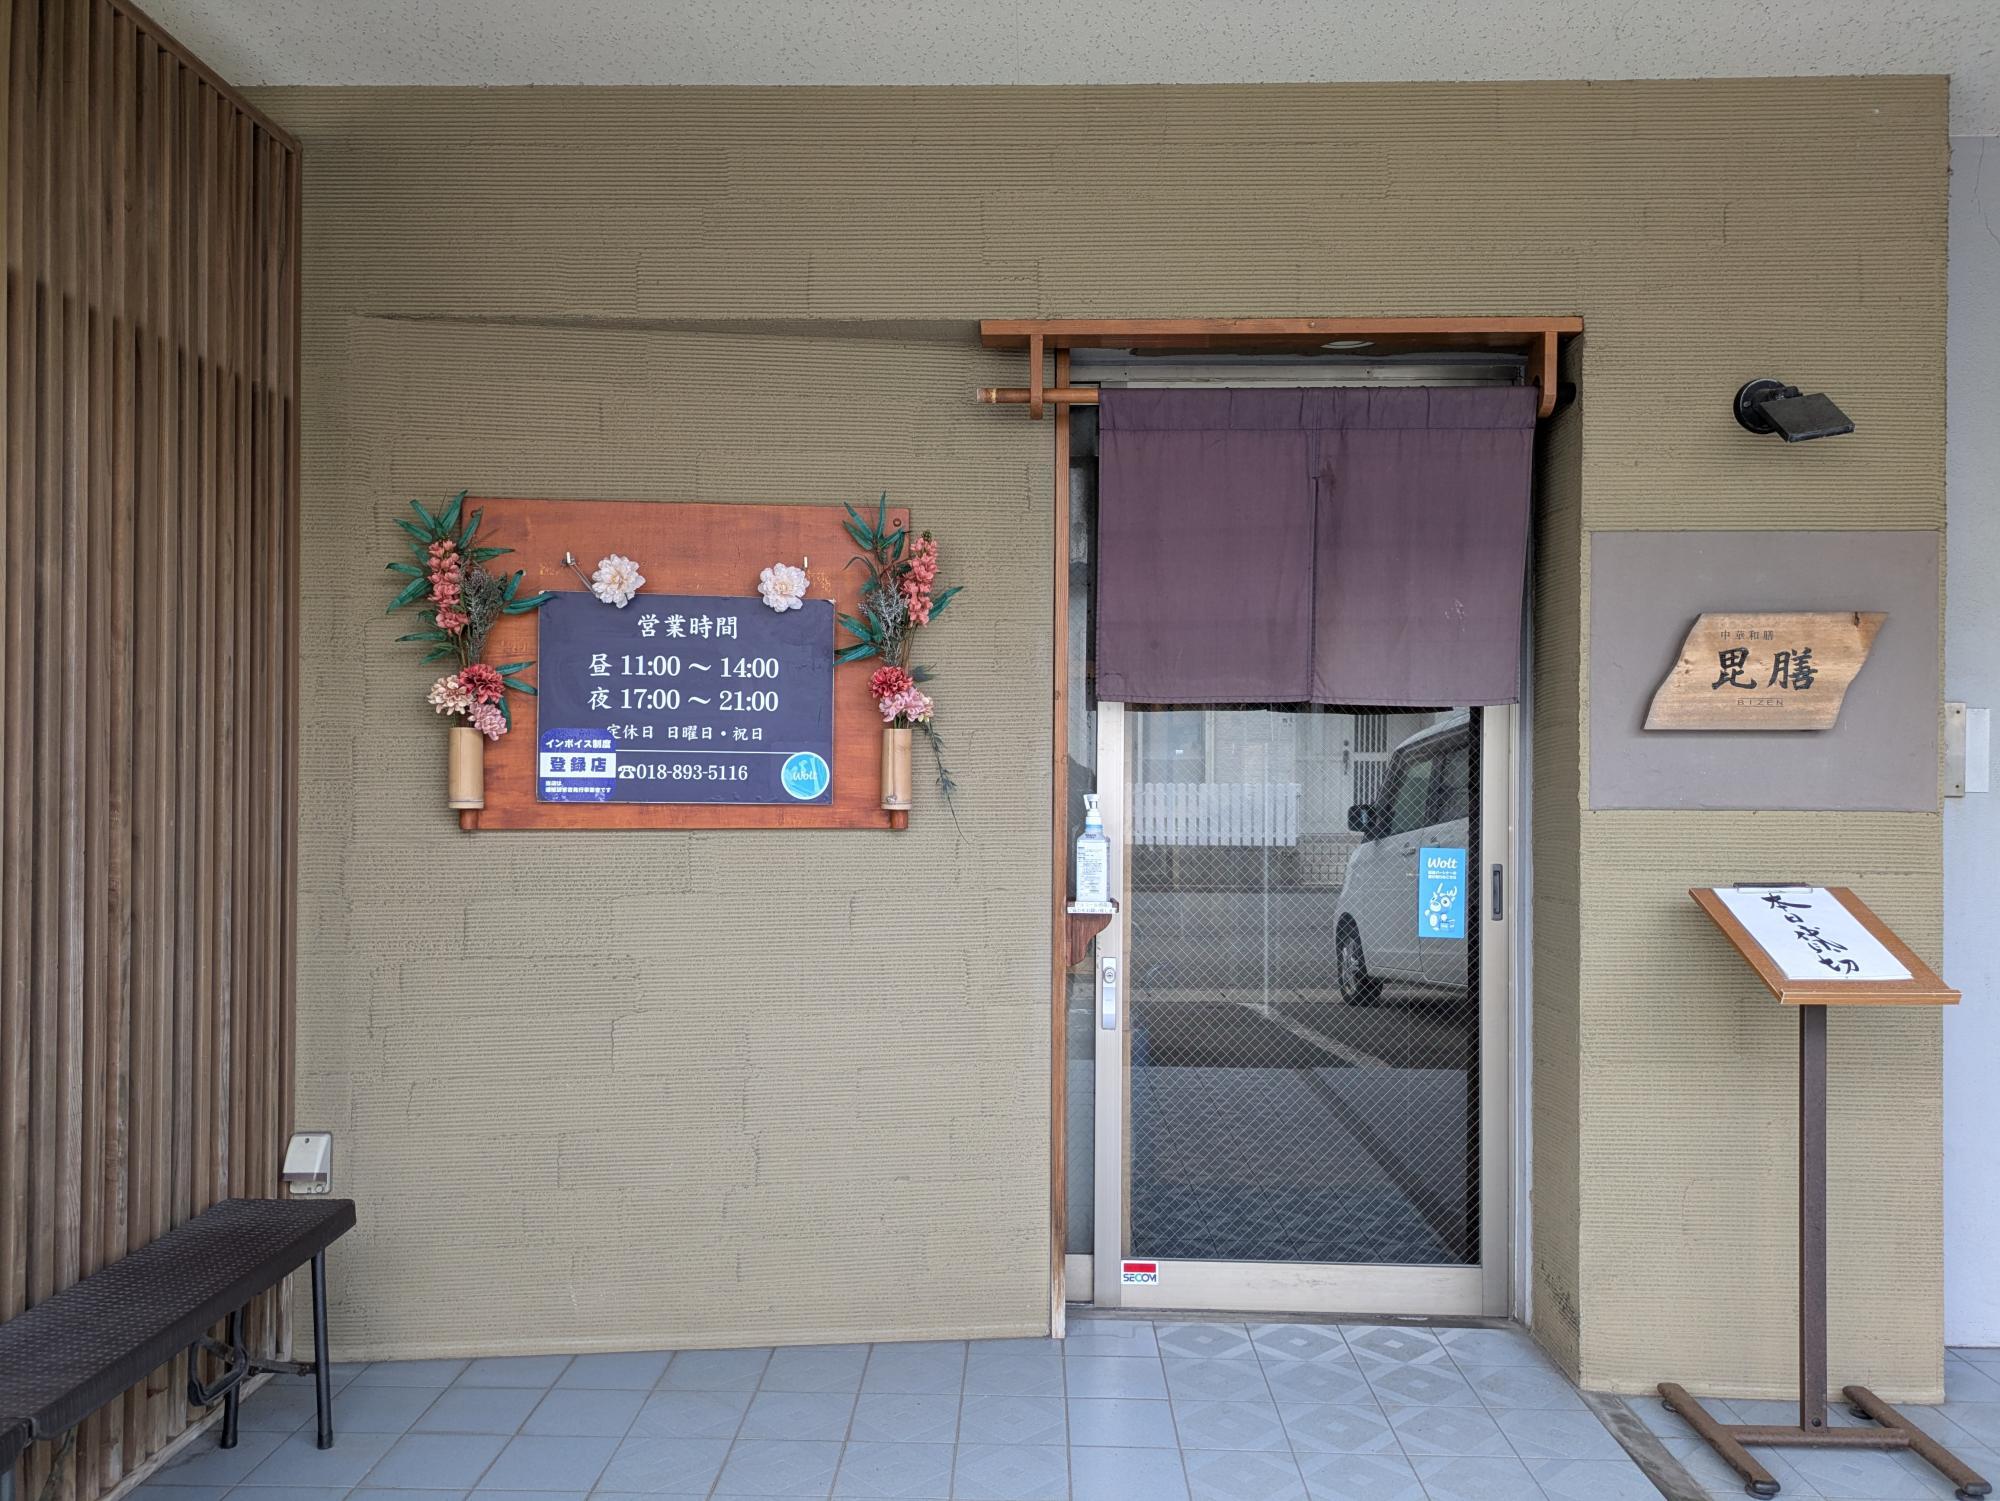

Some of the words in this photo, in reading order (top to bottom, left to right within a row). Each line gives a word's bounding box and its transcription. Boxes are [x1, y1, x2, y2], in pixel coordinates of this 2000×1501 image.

[637, 613, 738, 640] 営業時間
[588, 652, 613, 677] 昼
[620, 655, 681, 677] 11:00
[719, 657, 779, 679] 14:00
[587, 686, 612, 711] 夜
[620, 688, 681, 711] 17:00
[719, 690, 779, 712] 21:00
[606, 724, 654, 740] 定休日
[666, 725, 763, 742] 日曜日・祝日
[545, 738, 612, 749] インボイス制度
[549, 756, 607, 773] 登録店
[1427, 857, 1458, 869] Wolt
[1123, 1273, 1157, 1282] SECOM
